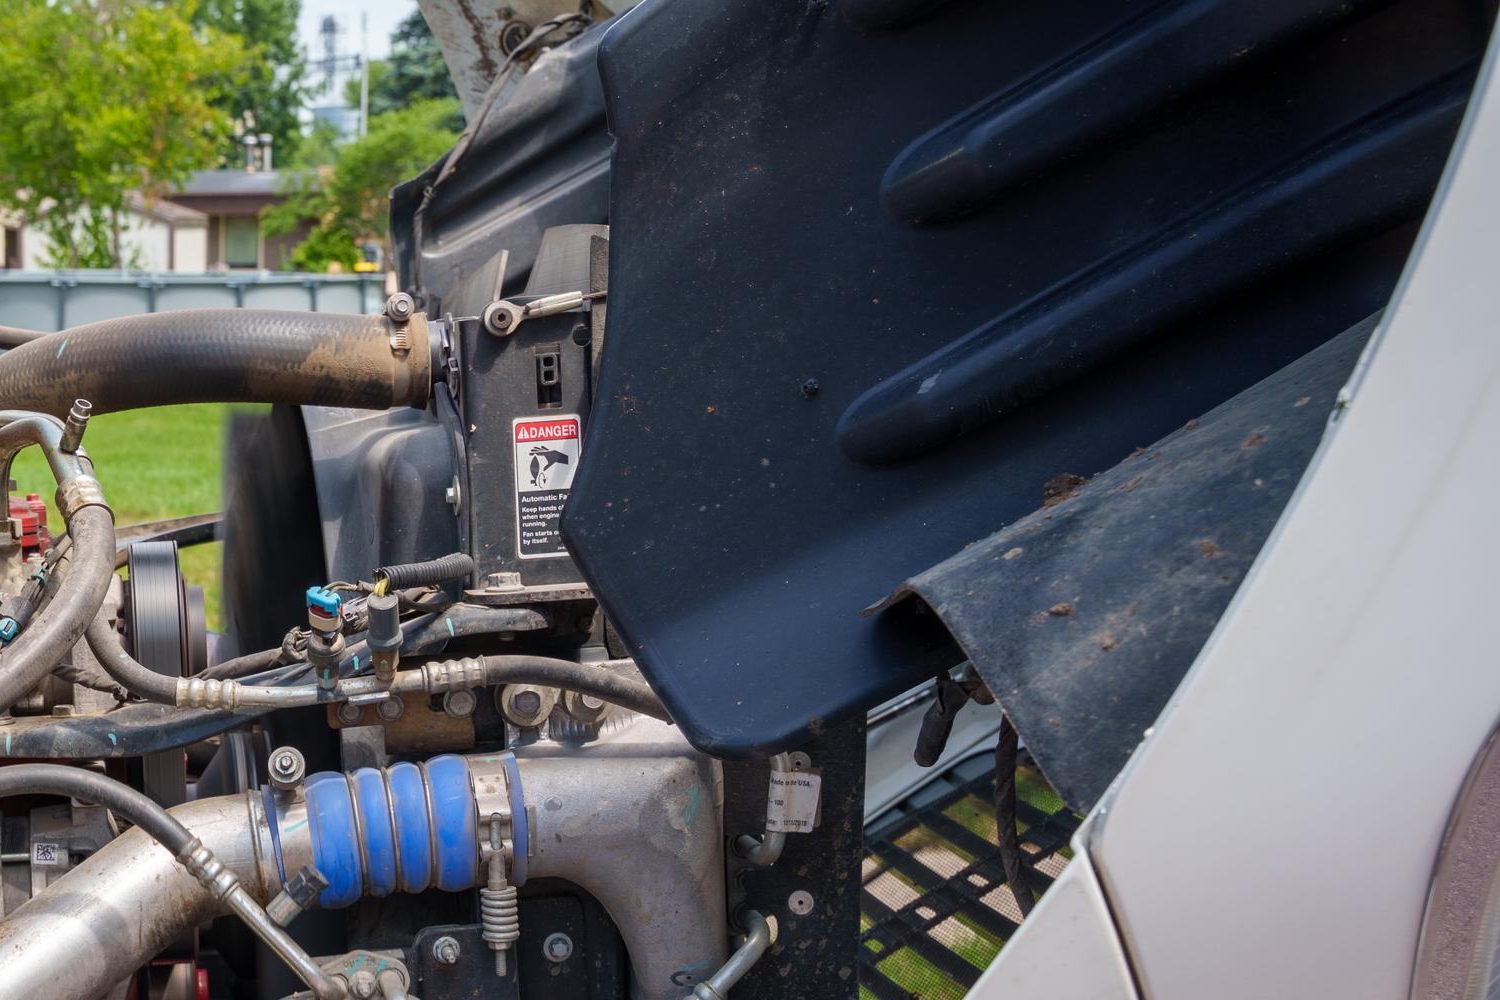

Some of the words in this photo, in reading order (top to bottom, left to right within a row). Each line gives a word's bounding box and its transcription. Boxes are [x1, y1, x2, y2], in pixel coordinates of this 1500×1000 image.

[530, 424, 576, 438] DANGER
[522, 494, 558, 503] Automatic
[522, 507, 537, 515] Keep
[539, 512, 560, 520] engine
